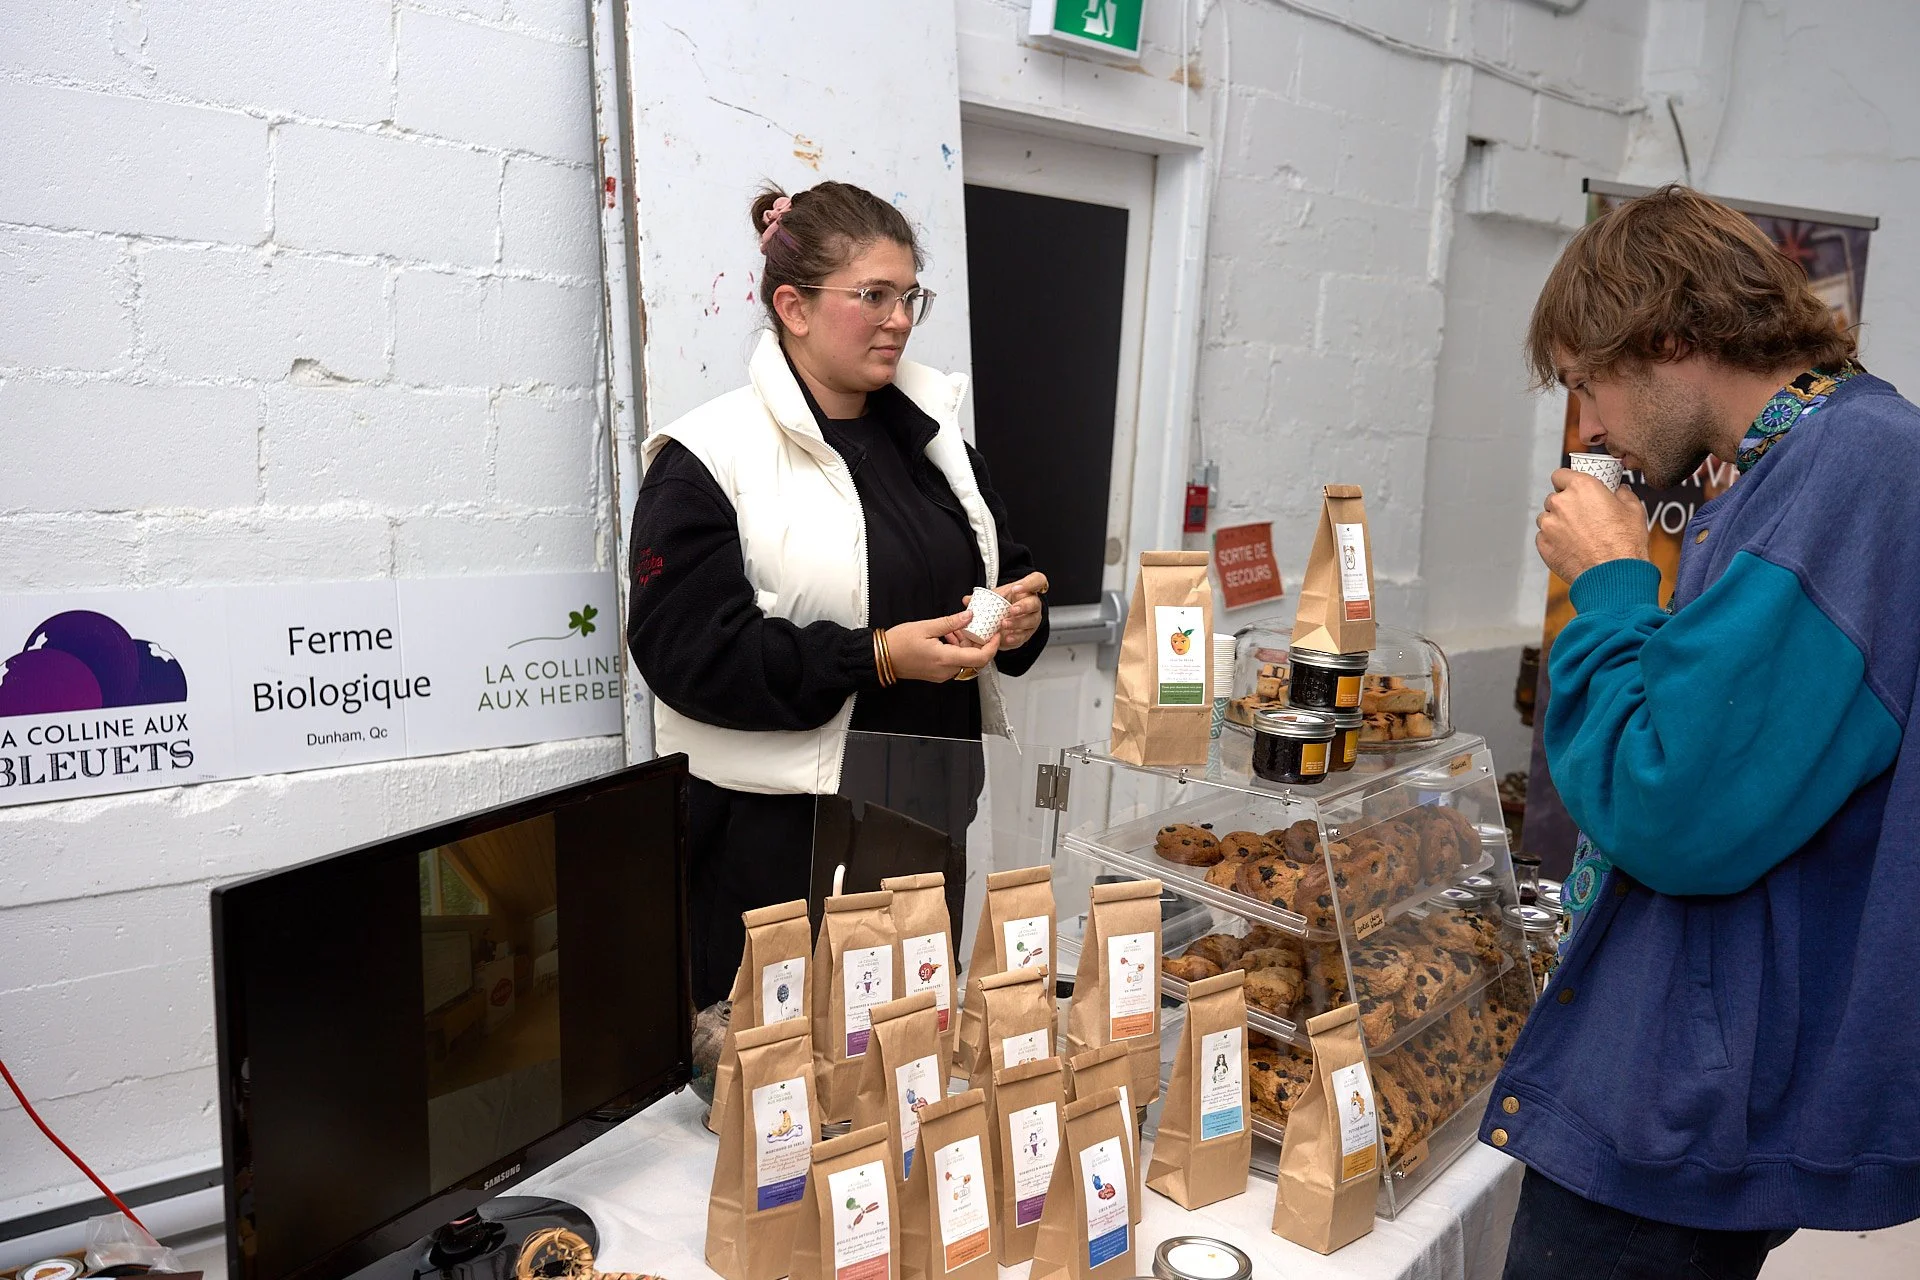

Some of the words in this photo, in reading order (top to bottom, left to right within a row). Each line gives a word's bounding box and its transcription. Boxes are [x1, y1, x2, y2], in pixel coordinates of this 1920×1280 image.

[1218, 544, 1254, 567] SORTIE
[1254, 541, 1268, 560] DE
[1225, 564, 1272, 588] SECOURS
[288, 626, 393, 656] Ferme
[486, 664, 515, 685] LA
[525, 655, 620, 681] COLLINE
[253, 673, 431, 714] Biologique
[478, 688, 529, 712] AUX
[541, 680, 620, 706] HERBE
[0, 730, 18, 749] A
[27, 718, 134, 745] COLLINE
[144, 713, 189, 735] AUX
[307, 730, 366, 746] Dunham,
[369, 726, 388, 740] Qc
[0, 738, 194, 788] BLEUETS
[483, 1163, 521, 1191] SAMSUNG
